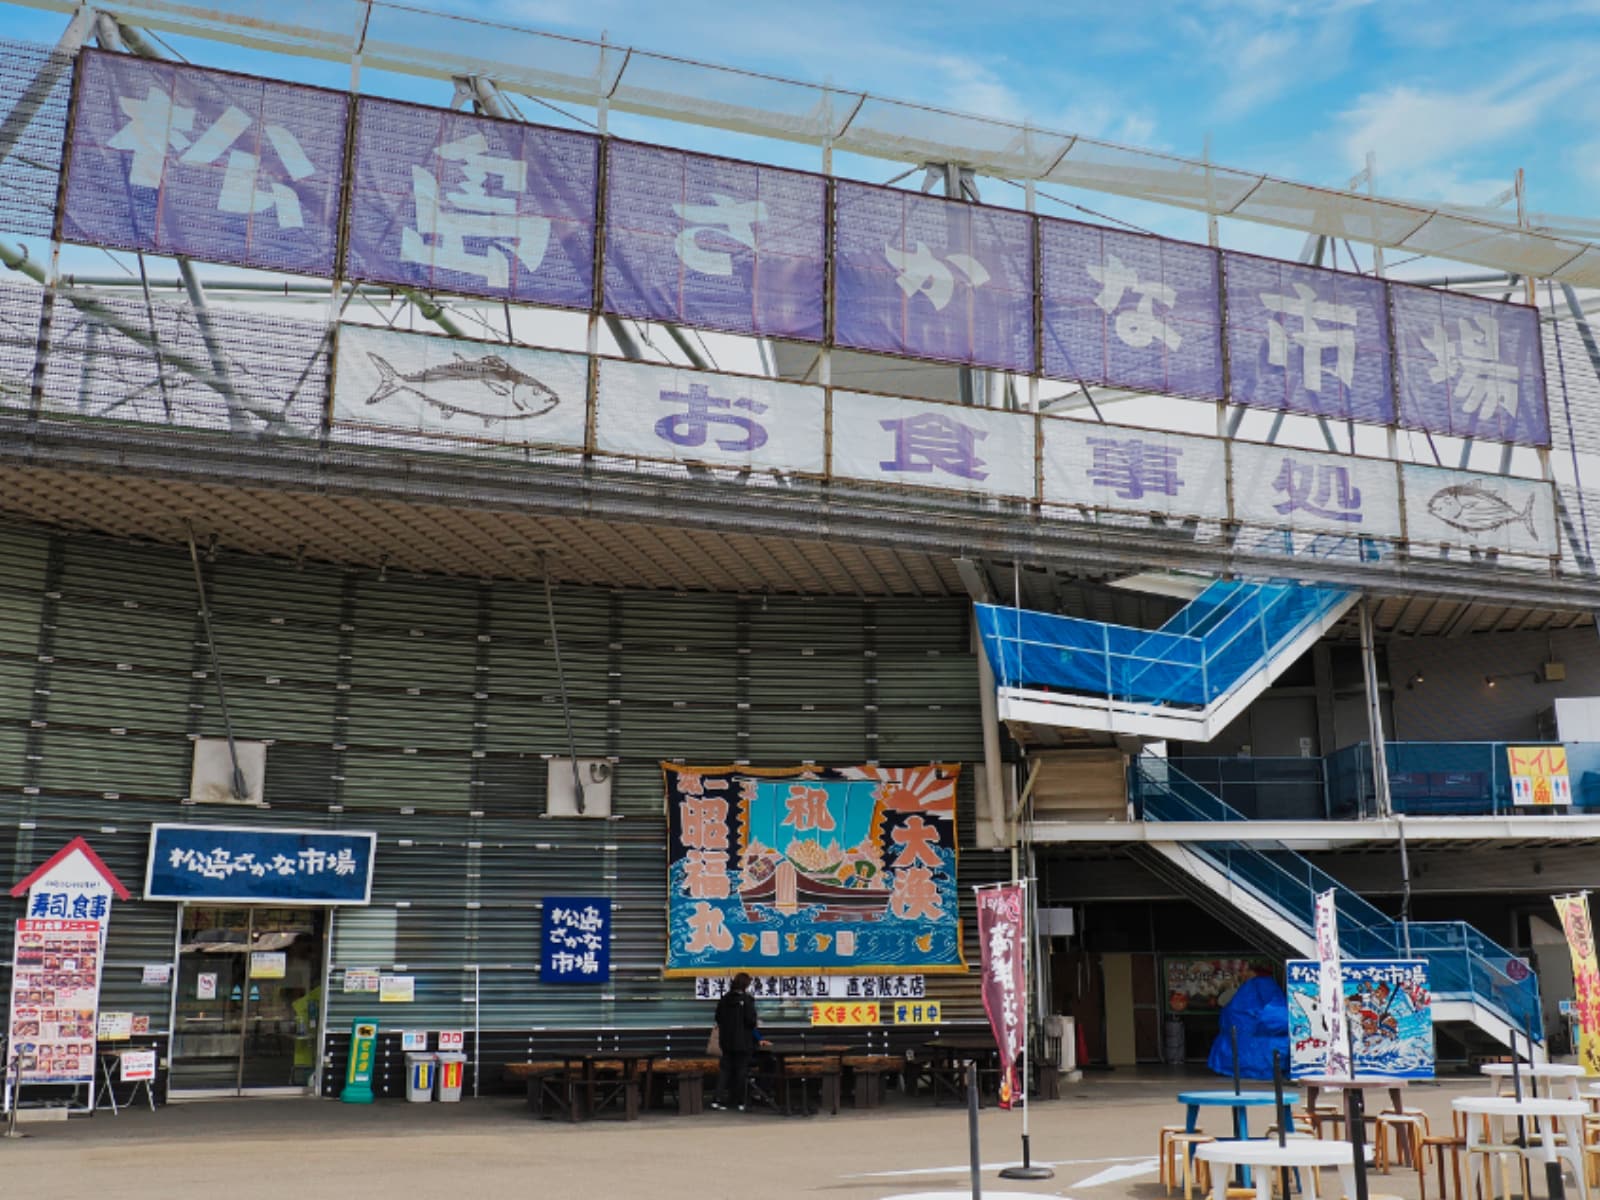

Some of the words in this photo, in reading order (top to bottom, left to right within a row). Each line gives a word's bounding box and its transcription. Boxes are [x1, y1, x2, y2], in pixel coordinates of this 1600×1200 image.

[106, 86, 1520, 421] 松島さかな市場
[654, 383, 1362, 523] お食事処
[1509, 748, 1567, 775] トイレ
[780, 785, 836, 832] 祝
[169, 847, 357, 881] 松島さかな市場
[889, 815, 944, 920] 大漁
[551, 905, 603, 932] 松島
[549, 927, 602, 950] さかな
[551, 951, 599, 974] 市場
[1290, 964, 1427, 985] 松さかな市場
[697, 976, 829, 998] 遠洋漁業昭福丸
[847, 976, 924, 997] 直営販売店
